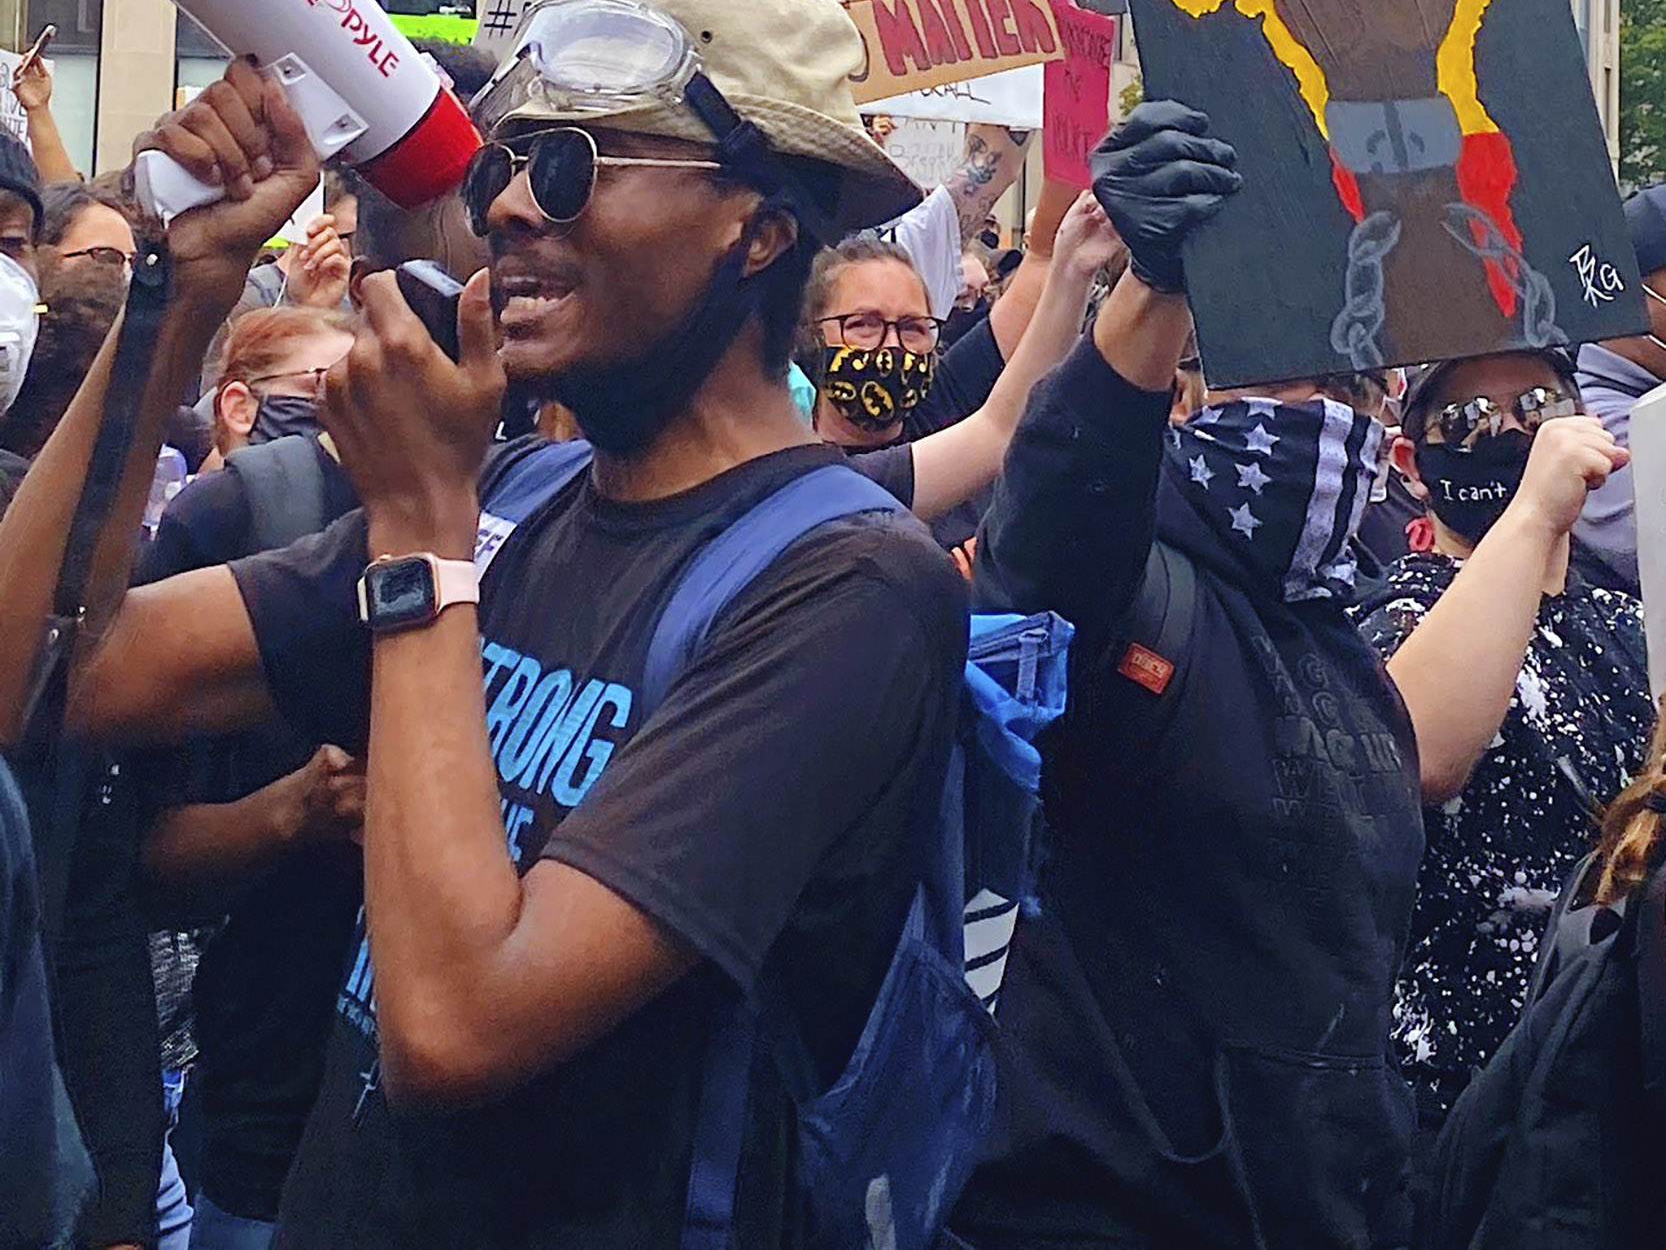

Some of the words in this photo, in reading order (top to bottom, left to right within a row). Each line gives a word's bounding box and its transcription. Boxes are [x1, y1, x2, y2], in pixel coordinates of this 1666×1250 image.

[340, 8, 399, 78] PYLE
[1440, 479, 1454, 501] I
[1458, 480, 1507, 501] can't
[479, 636, 632, 807] TRONG
